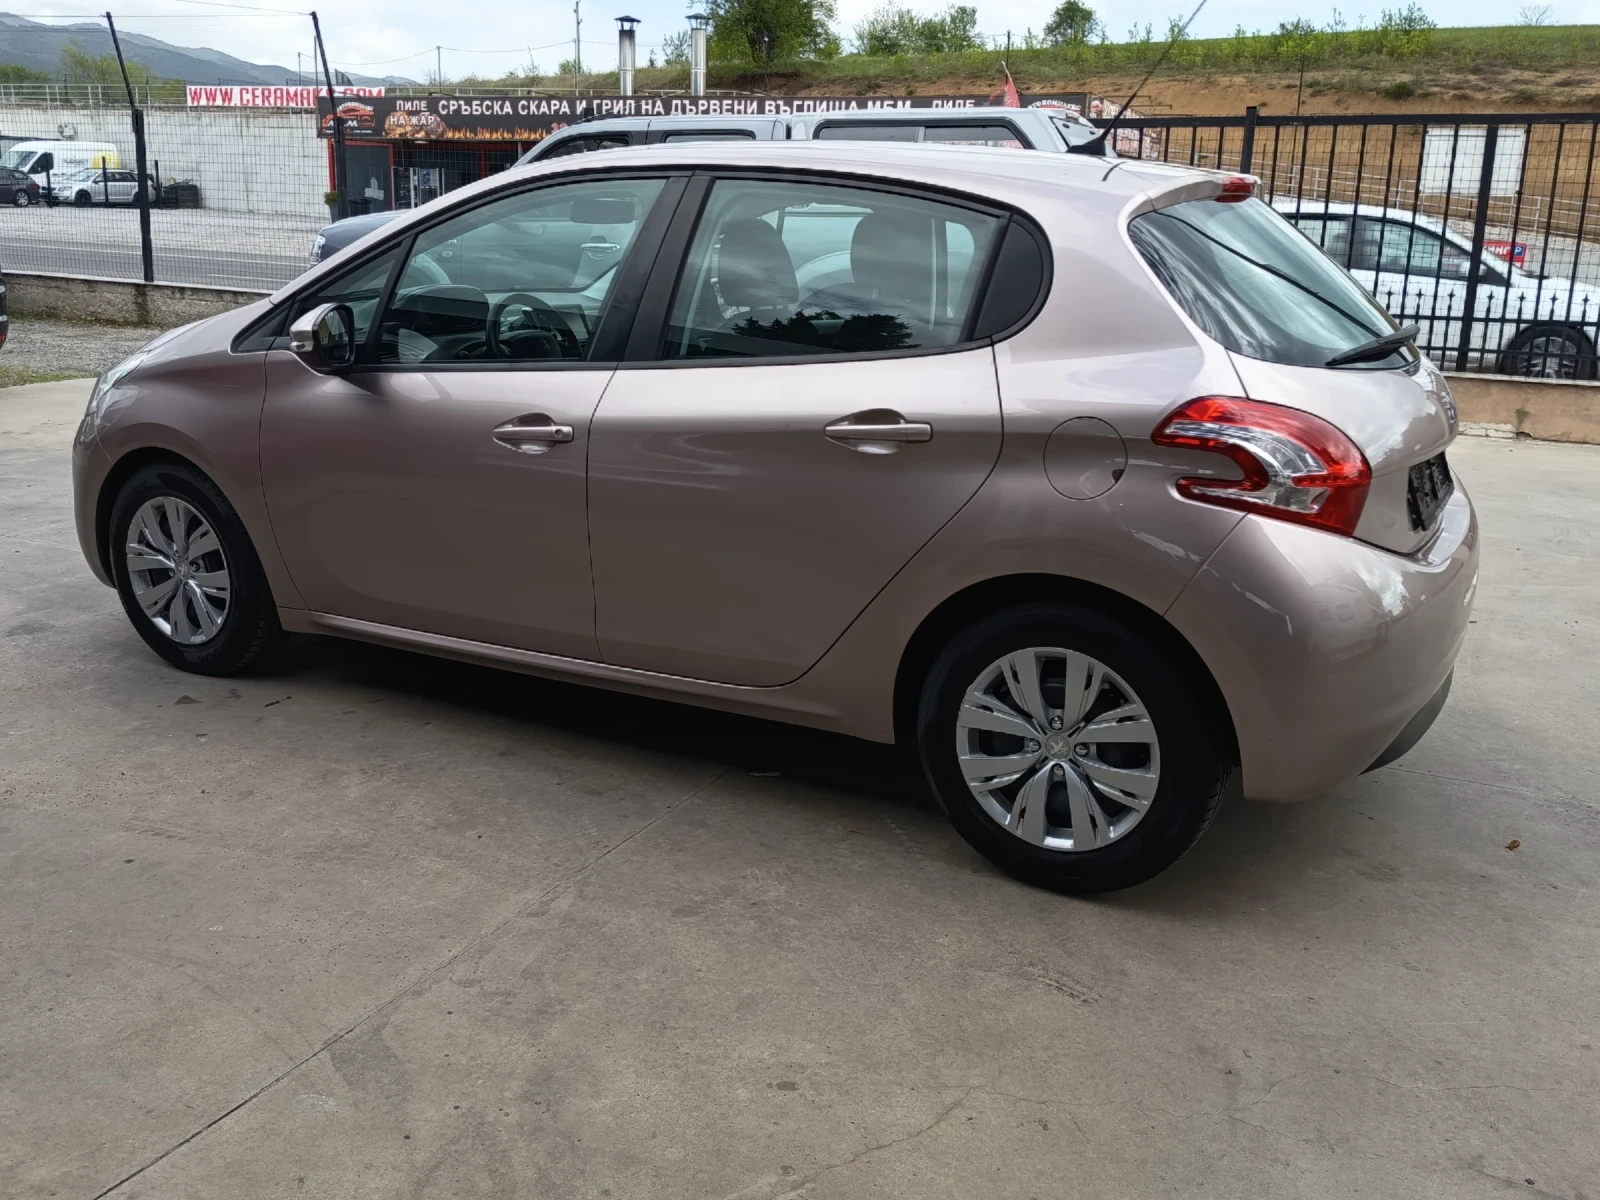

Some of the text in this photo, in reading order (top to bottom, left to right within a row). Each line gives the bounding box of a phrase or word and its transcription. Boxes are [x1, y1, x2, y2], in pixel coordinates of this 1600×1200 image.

[396, 100, 428, 111] ПИЛЕ
[438, 100, 513, 115] СРЪБСКА
[518, 100, 571, 115] СКАРА
[576, 100, 587, 115] И
[593, 100, 635, 115] ГРИЛ
[641, 100, 665, 115] НА
[670, 100, 758, 115] ДЪРВЕНИ
[390, 115, 435, 125] НА ЖАР
[1483, 245, 1512, 255] ИНГ
